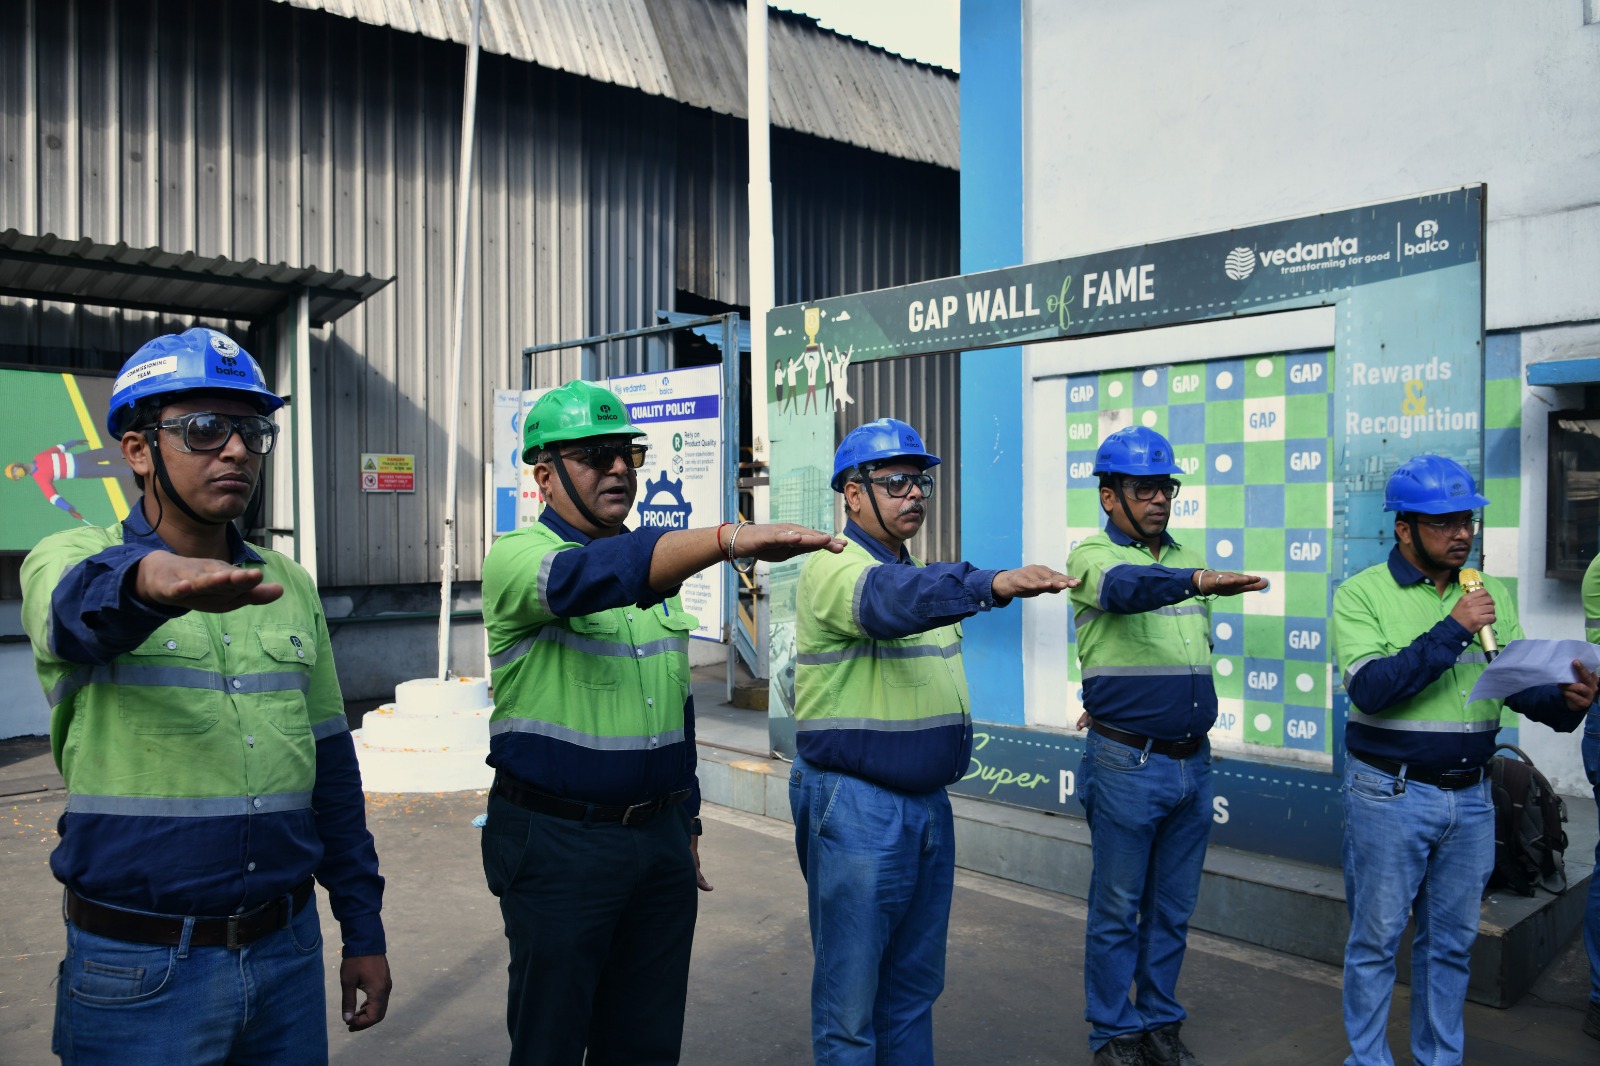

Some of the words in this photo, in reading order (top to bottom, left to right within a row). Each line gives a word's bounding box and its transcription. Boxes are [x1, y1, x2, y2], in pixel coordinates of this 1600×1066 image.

[1259, 236, 1358, 267] vedanta
[1404, 238, 1449, 256] balco
[1281, 256, 1346, 274] transforming
[1348, 255, 1363, 265] for
[1365, 251, 1390, 263] good
[908, 295, 958, 333] GAP
[966, 283, 1040, 325] WALL
[1046, 275, 1075, 330] of
[1083, 264, 1155, 309] FAME
[137, 370, 151, 379] TEAM
[216, 365, 246, 377] balco
[1290, 363, 1323, 383] GAP
[1352, 356, 1452, 386] Rewards
[623, 384, 647, 393] vedanta
[659, 387, 673, 395] balco
[1172, 374, 1199, 393] GAP
[1070, 385, 1094, 402] GAP
[1401, 379, 1428, 416] &
[631, 404, 664, 420] QUALITY
[666, 401, 696, 416] POLICY
[1249, 411, 1276, 429] GAP
[1069, 423, 1092, 440] GAP
[1346, 406, 1478, 439] Recognition
[684, 431, 693, 440] Rely
[701, 439, 716, 448] Quality
[1069, 462, 1094, 479] GAP
[1290, 452, 1321, 471] GAP
[1173, 500, 1199, 516] GAP
[643, 511, 685, 528] PROACT
[1290, 542, 1322, 561] GAP
[1288, 630, 1321, 649] GAP
[1248, 671, 1278, 690] GAP
[1287, 719, 1317, 739] GAP
[961, 733, 1050, 794] Super
